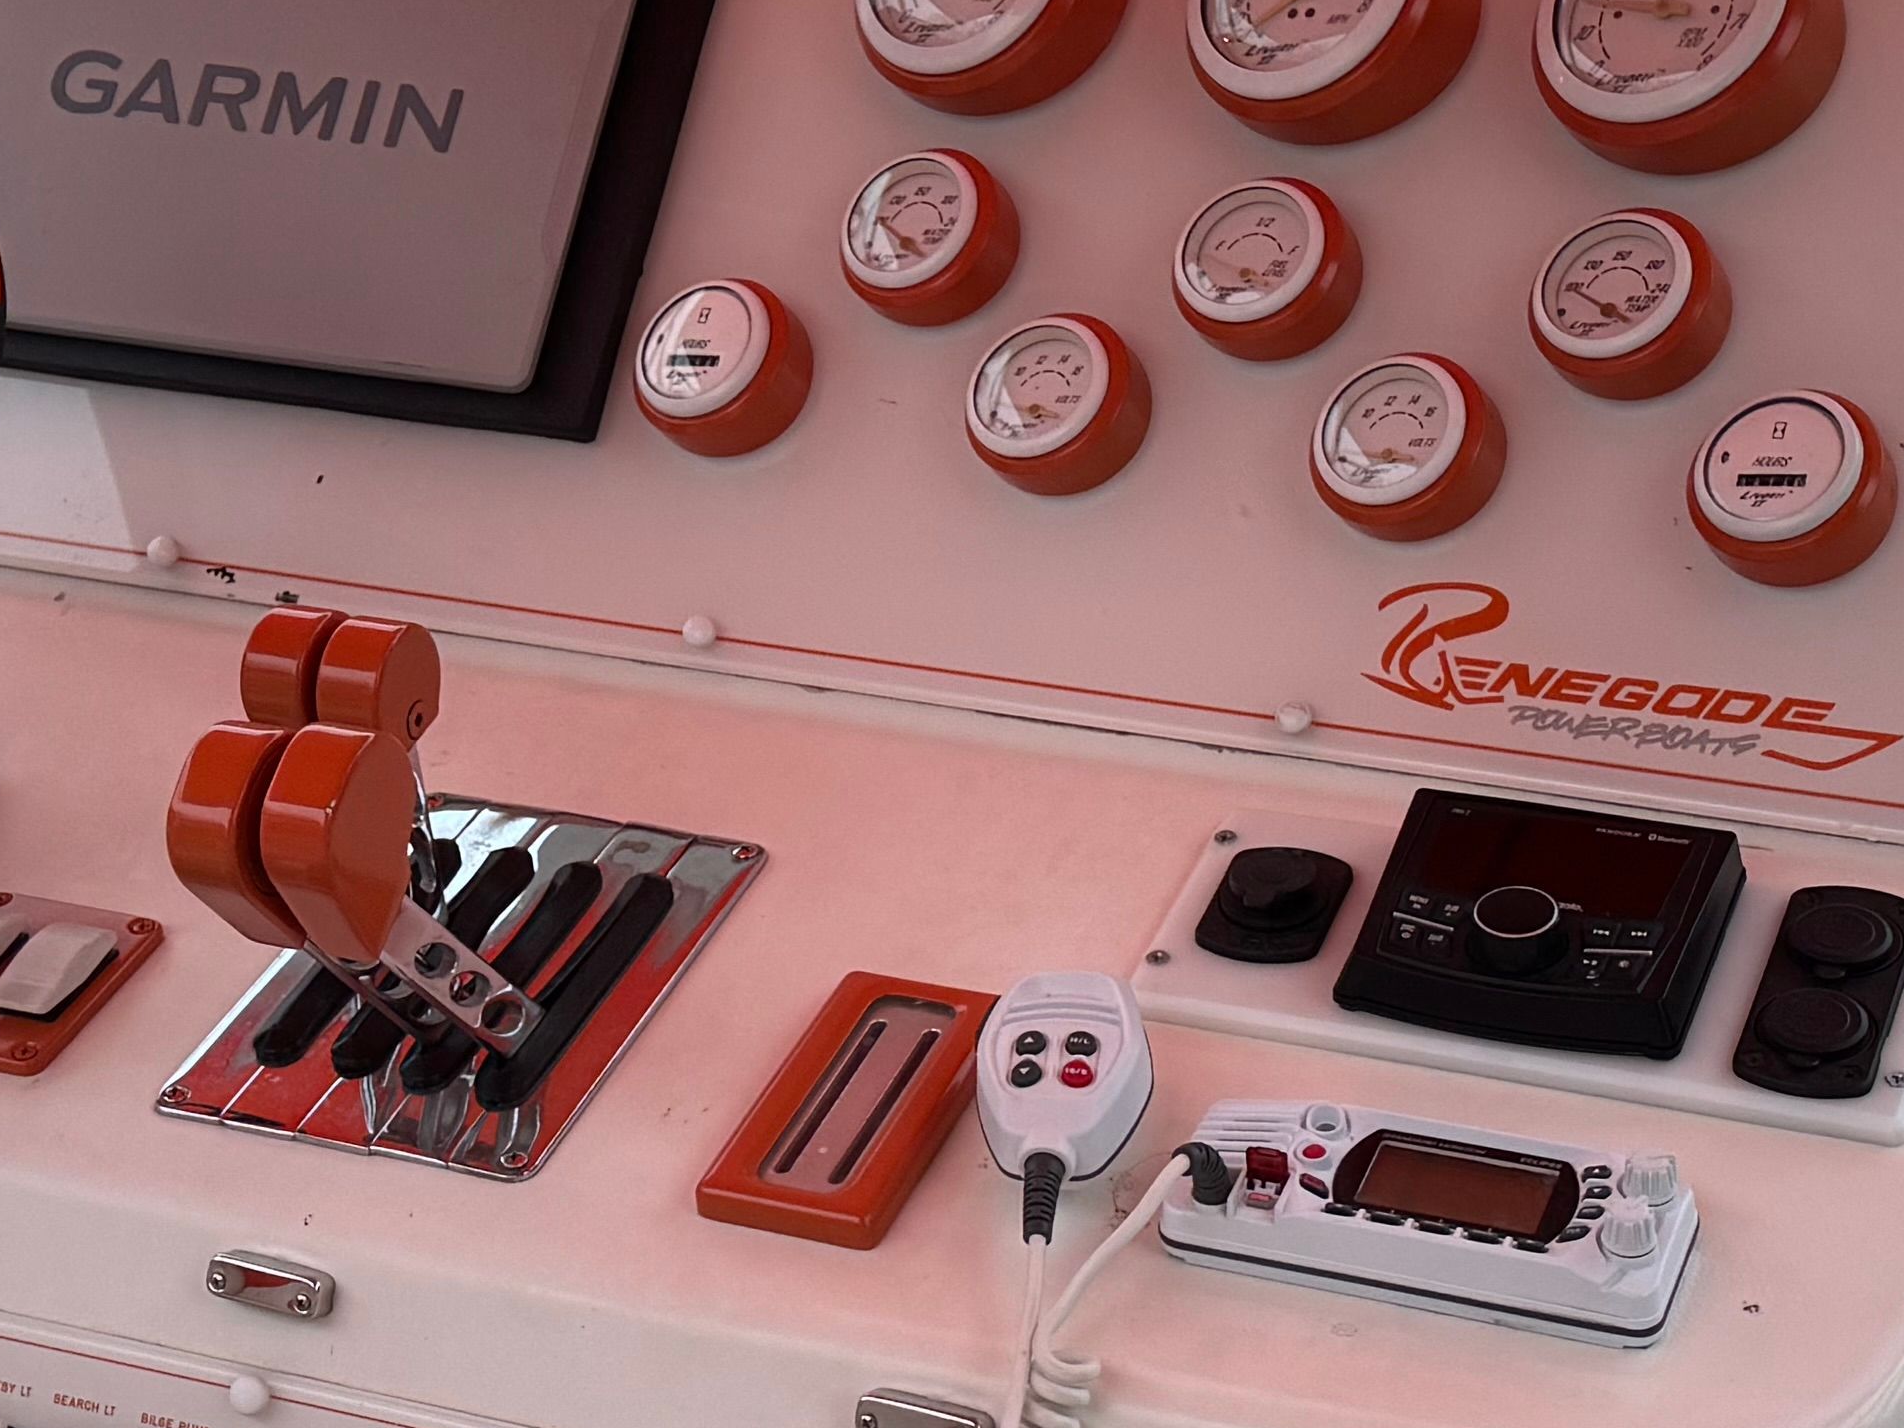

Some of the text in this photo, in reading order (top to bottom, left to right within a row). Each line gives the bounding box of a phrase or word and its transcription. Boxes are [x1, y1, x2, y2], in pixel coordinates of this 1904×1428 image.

[50, 49, 465, 154] GARMIN
[1361, 582, 1903, 740] RENEGADE
[1508, 704, 1761, 756] POWERBOATS
[20, 1385, 32, 1397] LT
[53, 1393, 116, 1417] SEARCH LT
